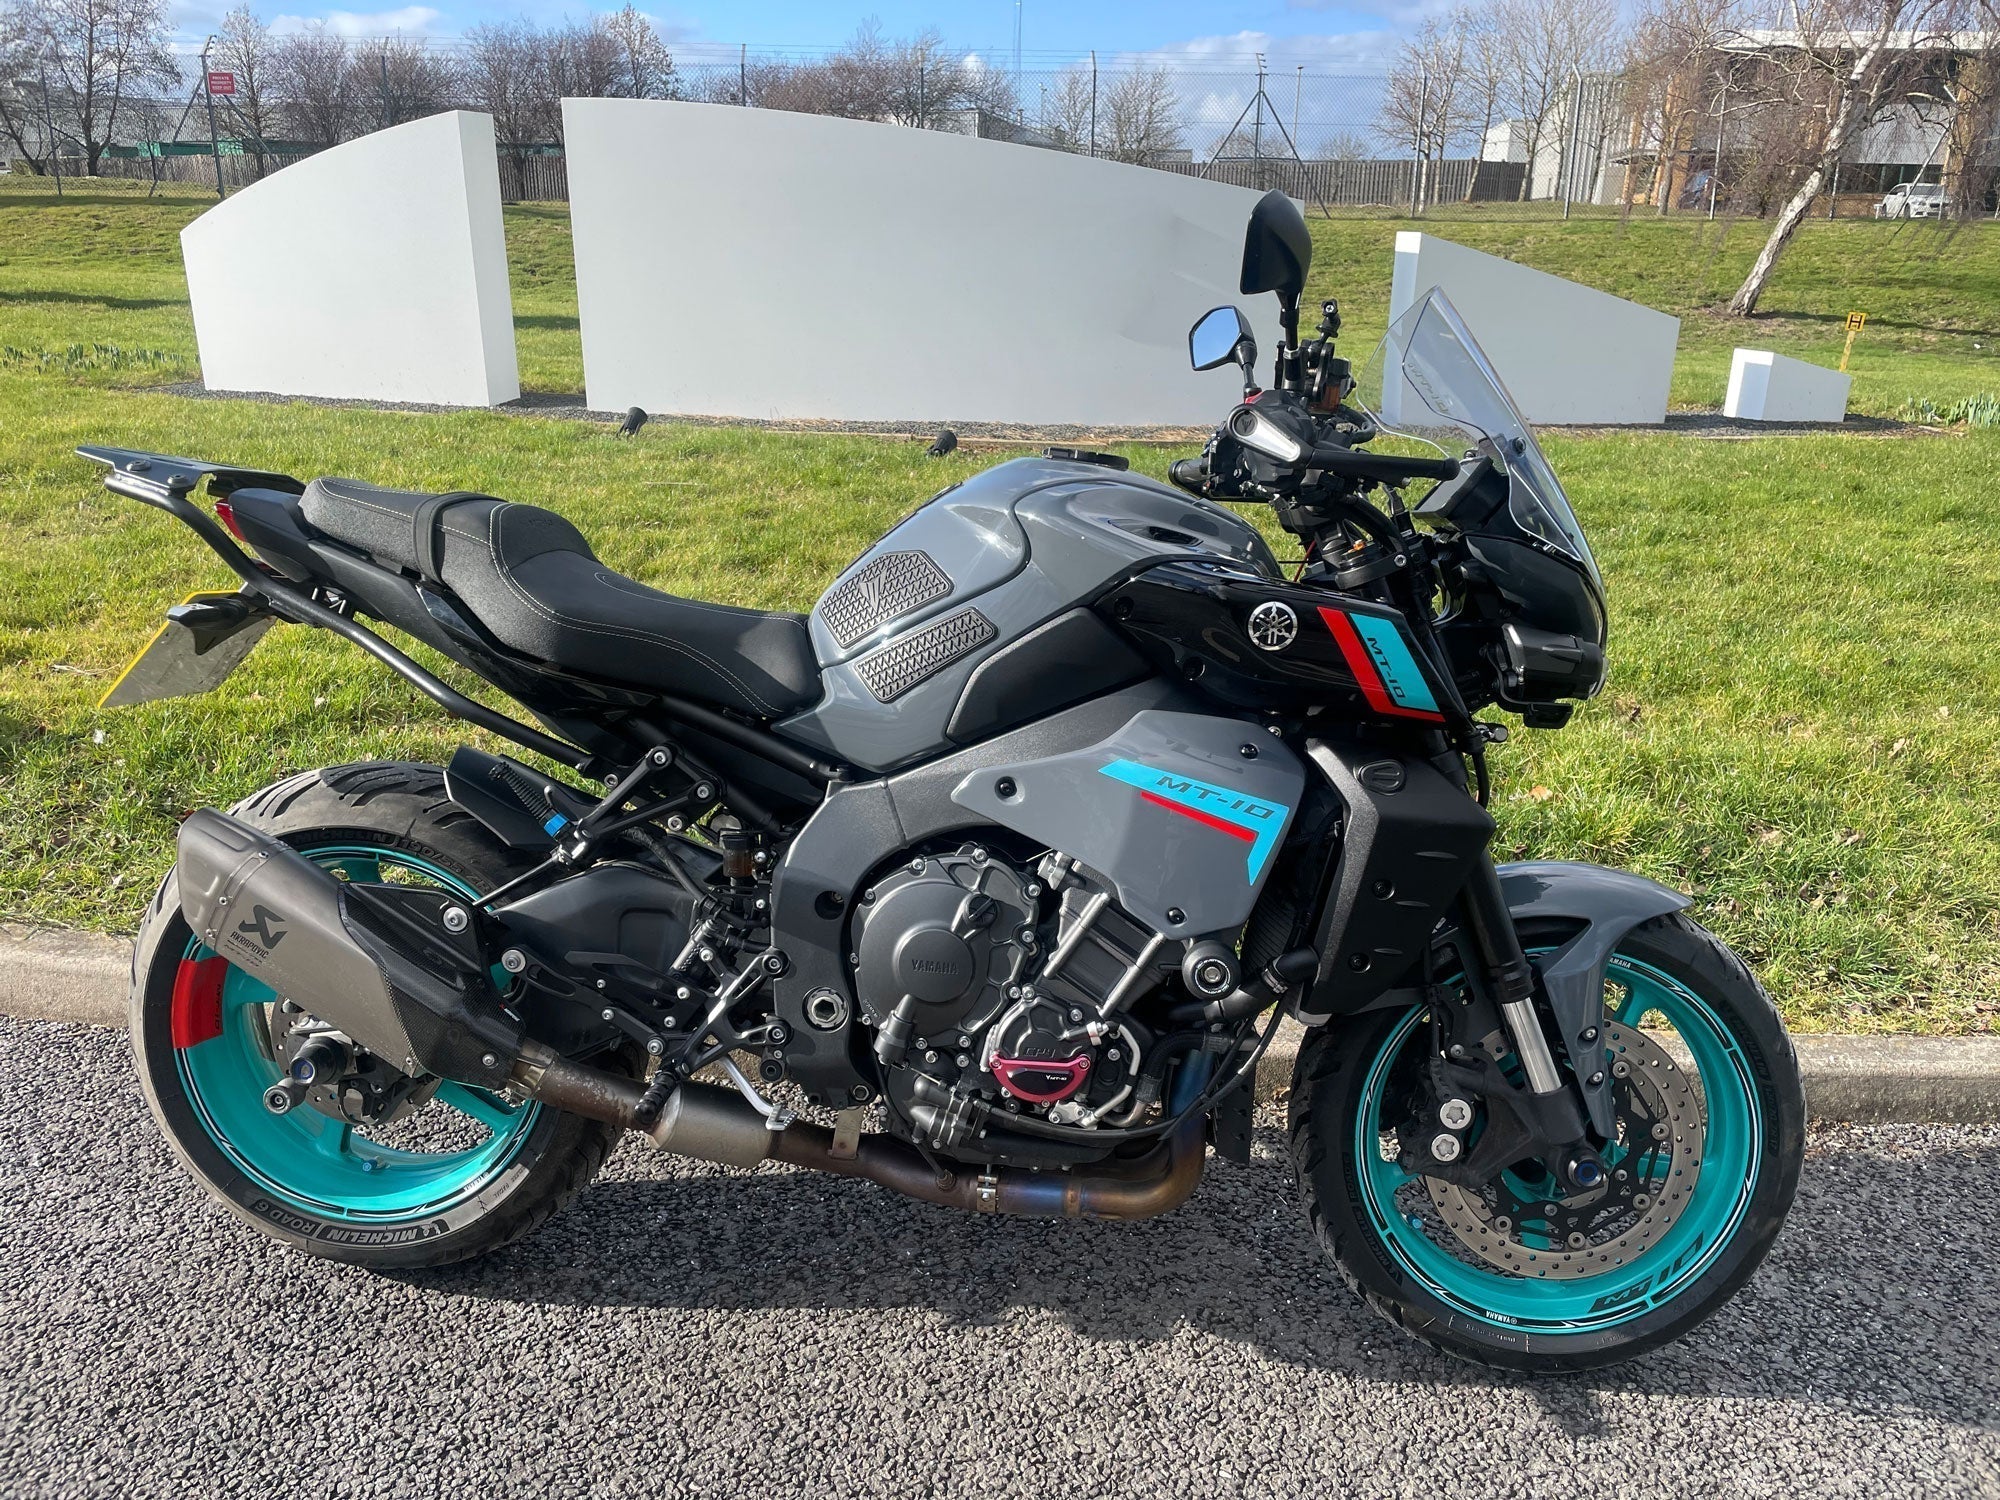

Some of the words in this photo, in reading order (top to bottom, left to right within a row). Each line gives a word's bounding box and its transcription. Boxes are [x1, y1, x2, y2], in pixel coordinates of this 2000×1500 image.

[1848, 314, 1863, 329] H
[1367, 637, 1406, 698] MT-10
[1156, 775, 1275, 820] MT-10
[295, 830, 387, 845] MICHELIN
[911, 958, 960, 975] YAMAHA
[1609, 957, 1631, 969] AMAHA
[270, 1209, 317, 1234] ROAD
[326, 1228, 418, 1244] MICHELIN
[1485, 1310, 1512, 1324] YAMAHA
